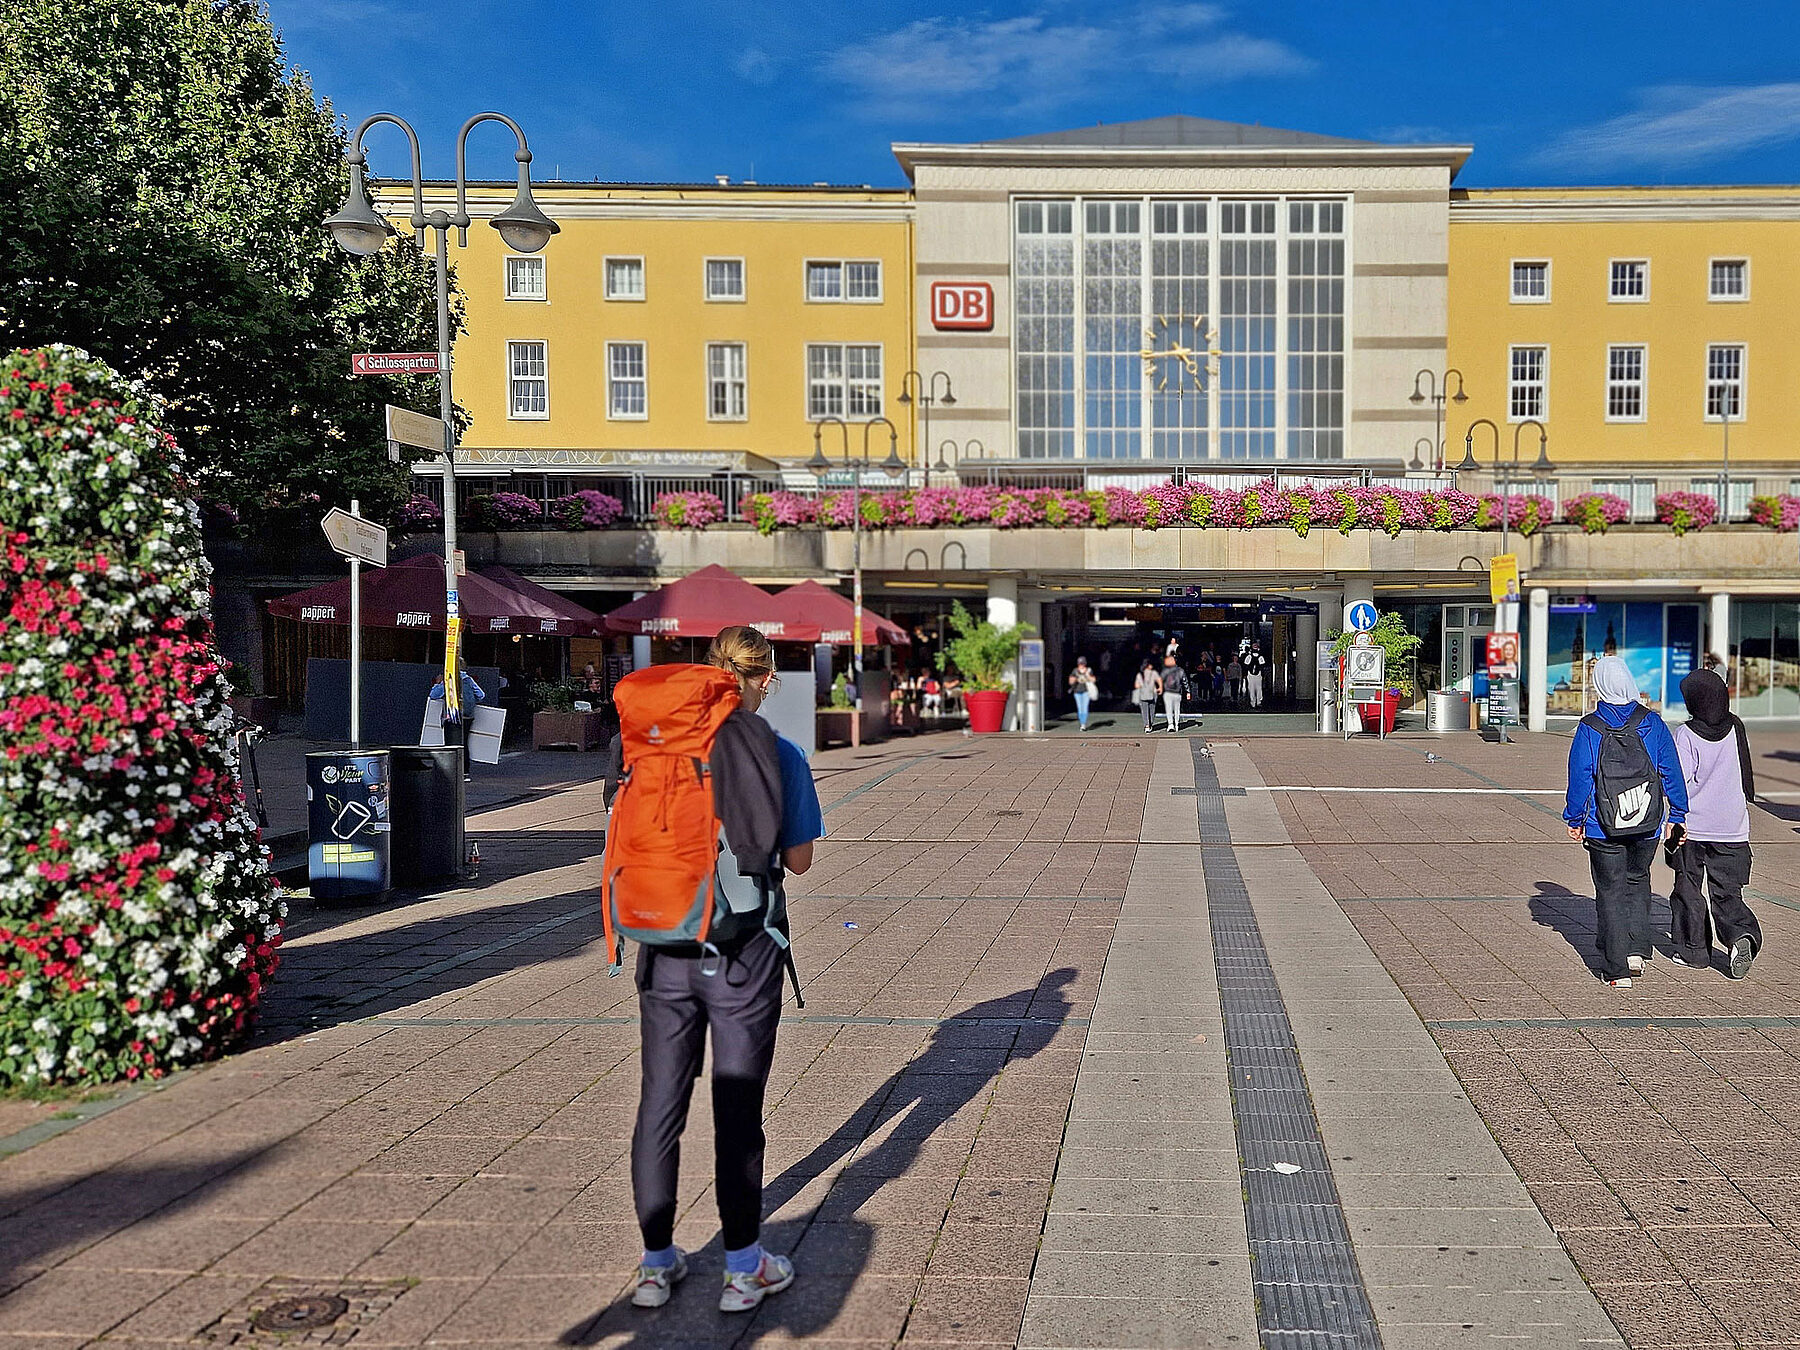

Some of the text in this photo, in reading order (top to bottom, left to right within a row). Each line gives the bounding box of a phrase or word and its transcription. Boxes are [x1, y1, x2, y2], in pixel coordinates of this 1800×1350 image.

[940, 290, 984, 319] DB
[368, 356, 435, 371] Schlossgarten
[301, 605, 336, 620] pappert
[396, 612, 432, 627] pappert
[641, 618, 680, 633] pappert
[1617, 780, 1650, 818] NIK
